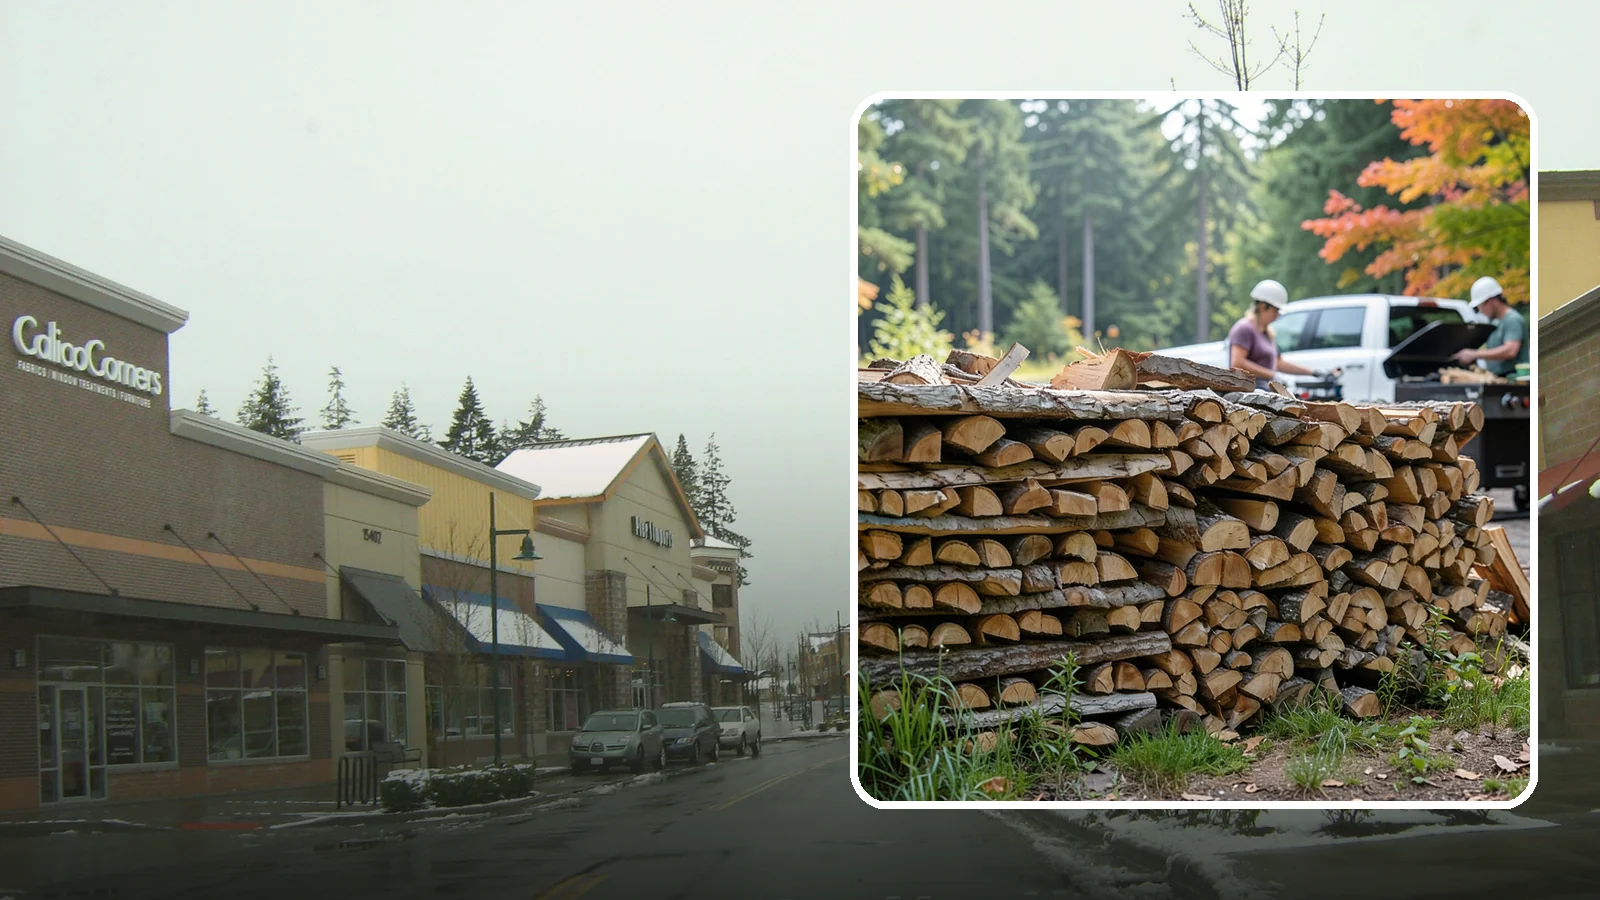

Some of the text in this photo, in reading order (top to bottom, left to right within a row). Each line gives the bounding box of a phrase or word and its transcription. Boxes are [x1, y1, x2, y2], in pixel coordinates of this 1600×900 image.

[17, 360, 47, 377] FABRICS
[51, 370, 78, 387] WINDOW
[78, 379, 116, 398] TREATMENTS
